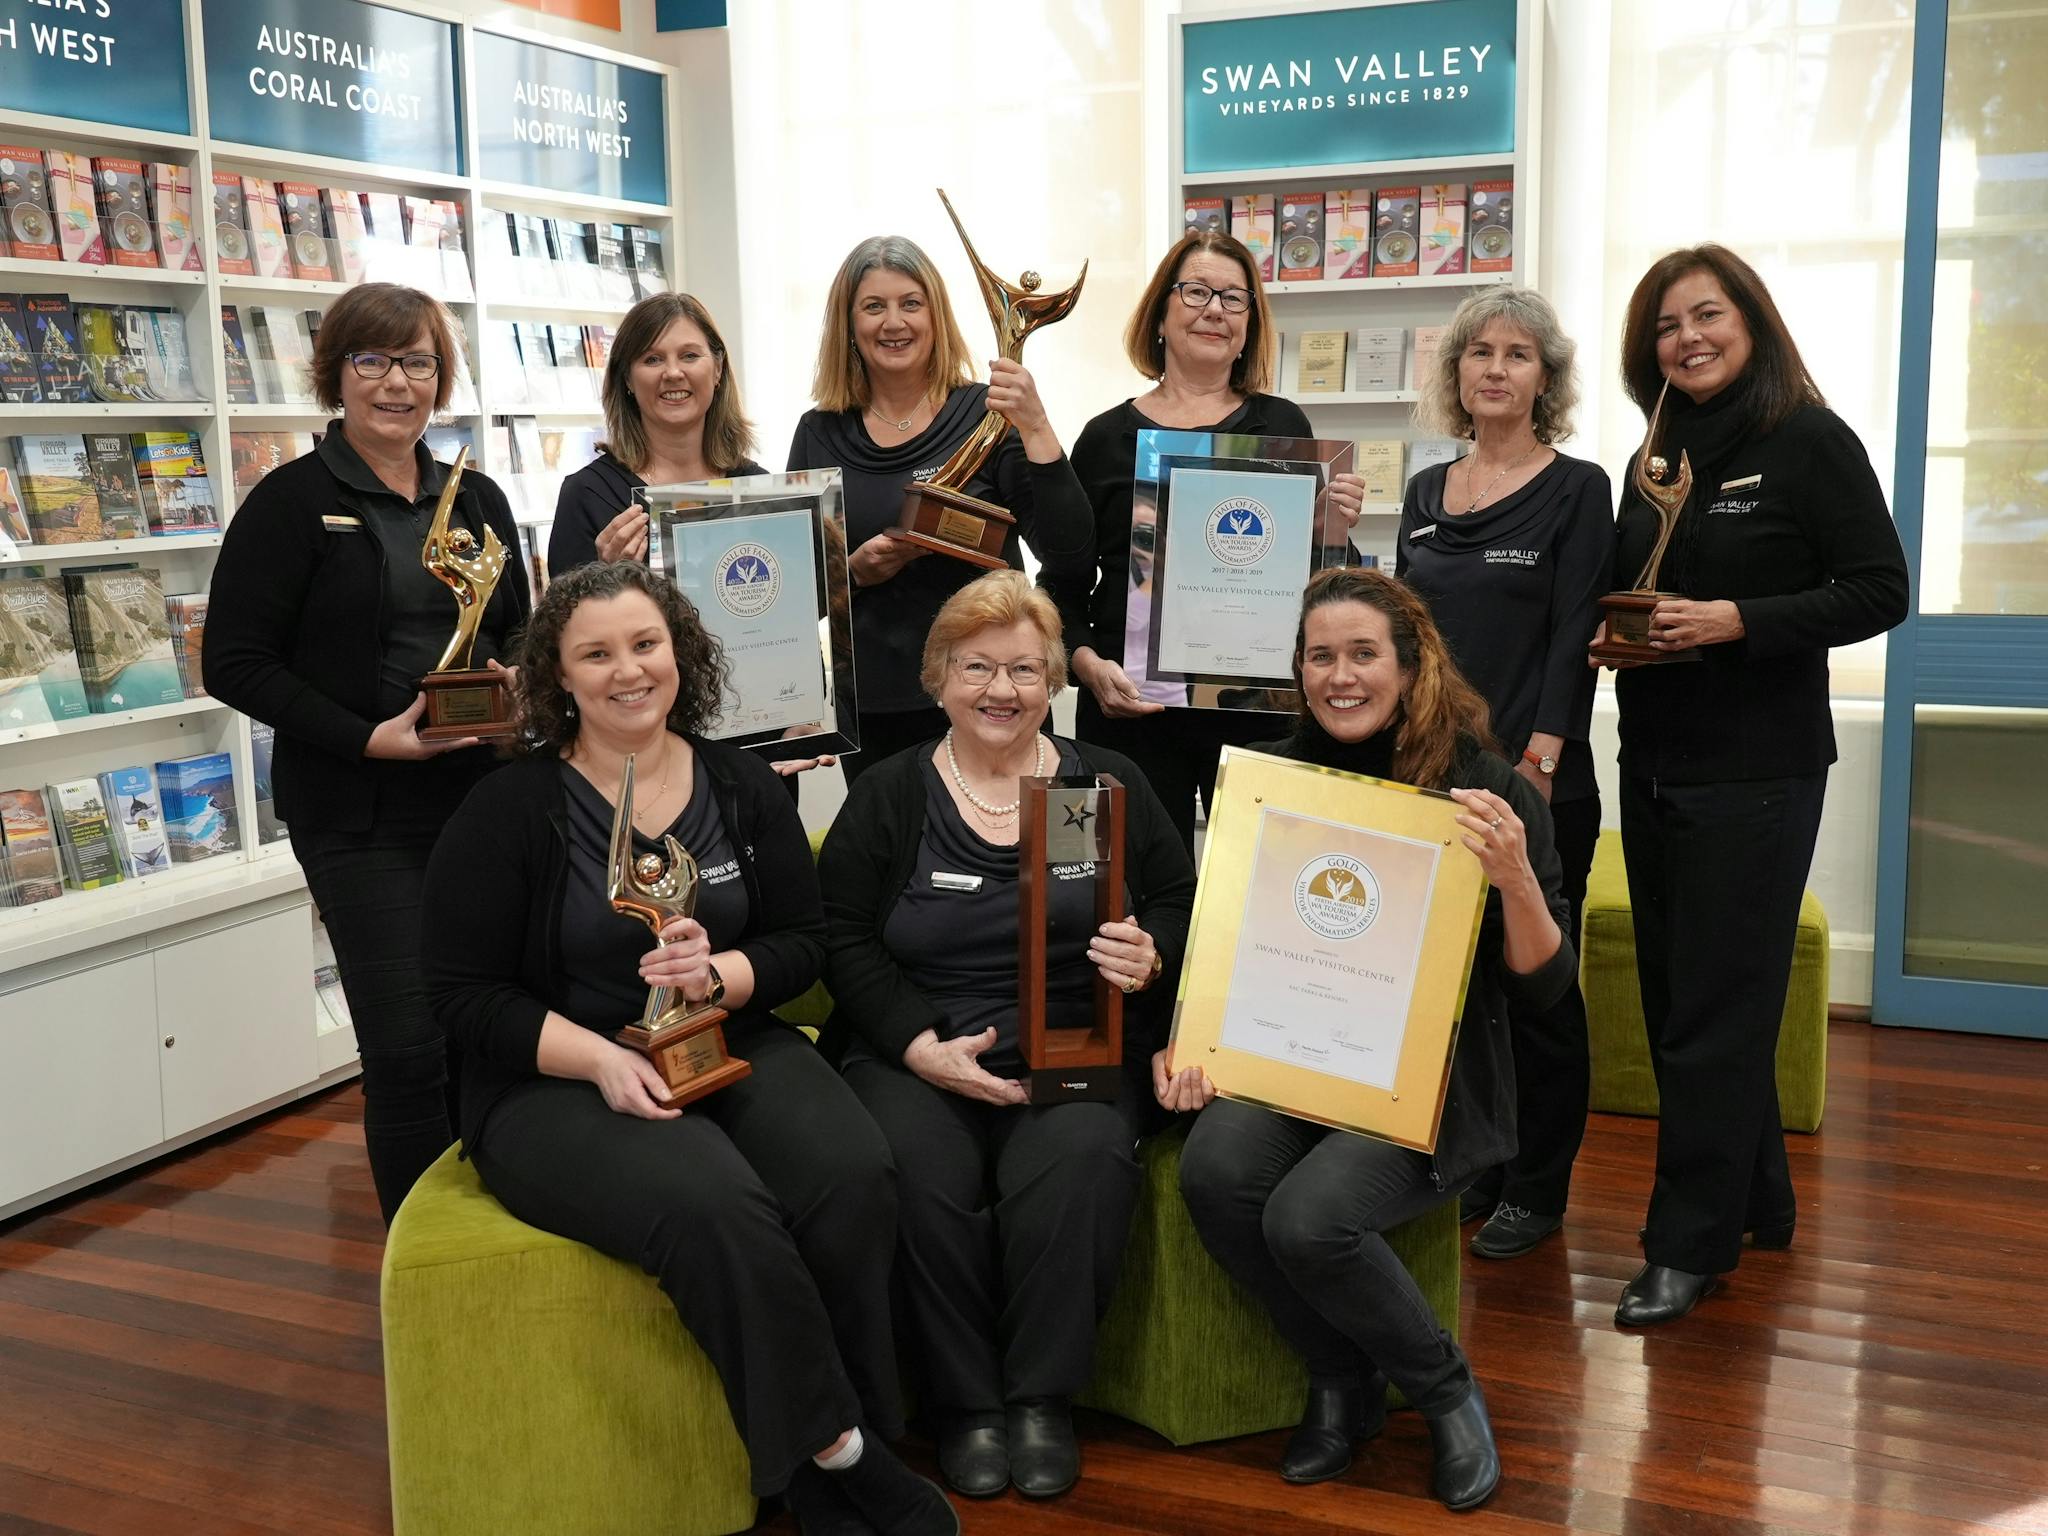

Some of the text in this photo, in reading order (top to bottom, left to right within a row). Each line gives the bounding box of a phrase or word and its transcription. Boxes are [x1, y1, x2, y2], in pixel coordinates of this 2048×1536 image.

[30, 22, 115, 66] WEST
[257, 24, 411, 80] AUSTRALIA'S
[1201, 44, 1492, 95] SWAN VALLEY
[249, 66, 422, 121] CORAL COAST
[513, 79, 628, 123] AUSTRALIA'S
[1219, 85, 1470, 116] VINEYARDS SINCE 1829
[512, 116, 632, 159] NORTH WEST
[150, 445, 190, 459] LetsGoKids
[912, 467, 936, 477] SWAN
[1214, 500, 1268, 521] HALL OF FAME
[1727, 500, 1760, 509] VALLEY
[1207, 523, 1272, 564] VISITOR INFORMATION SERVICES
[721, 547, 774, 570] HALL OF FAME
[1483, 549, 1540, 560] SWAN VALLEY
[1211, 567, 1226, 575] 2017
[717, 567, 778, 615] VISITOR INFORMATION AND SERVICES
[738, 594, 762, 602] AWARDS
[740, 588, 767, 596] TOURISM
[1176, 584, 1296, 598] SWAN VALLEY VISITOR CENTRE
[700, 864, 727, 879] SWAN
[1052, 864, 1081, 875] SWAN
[1327, 858, 1359, 873] GOLD
[1298, 880, 1377, 936] VISITOR INFORMATION SERVICES
[1344, 895, 1365, 906] 2019
[1311, 901, 1357, 918] WA TOURISM
[1319, 911, 1349, 923] AWARDS
[1254, 943, 1396, 985] SWAN VALLEY VISITOR CENTRE
